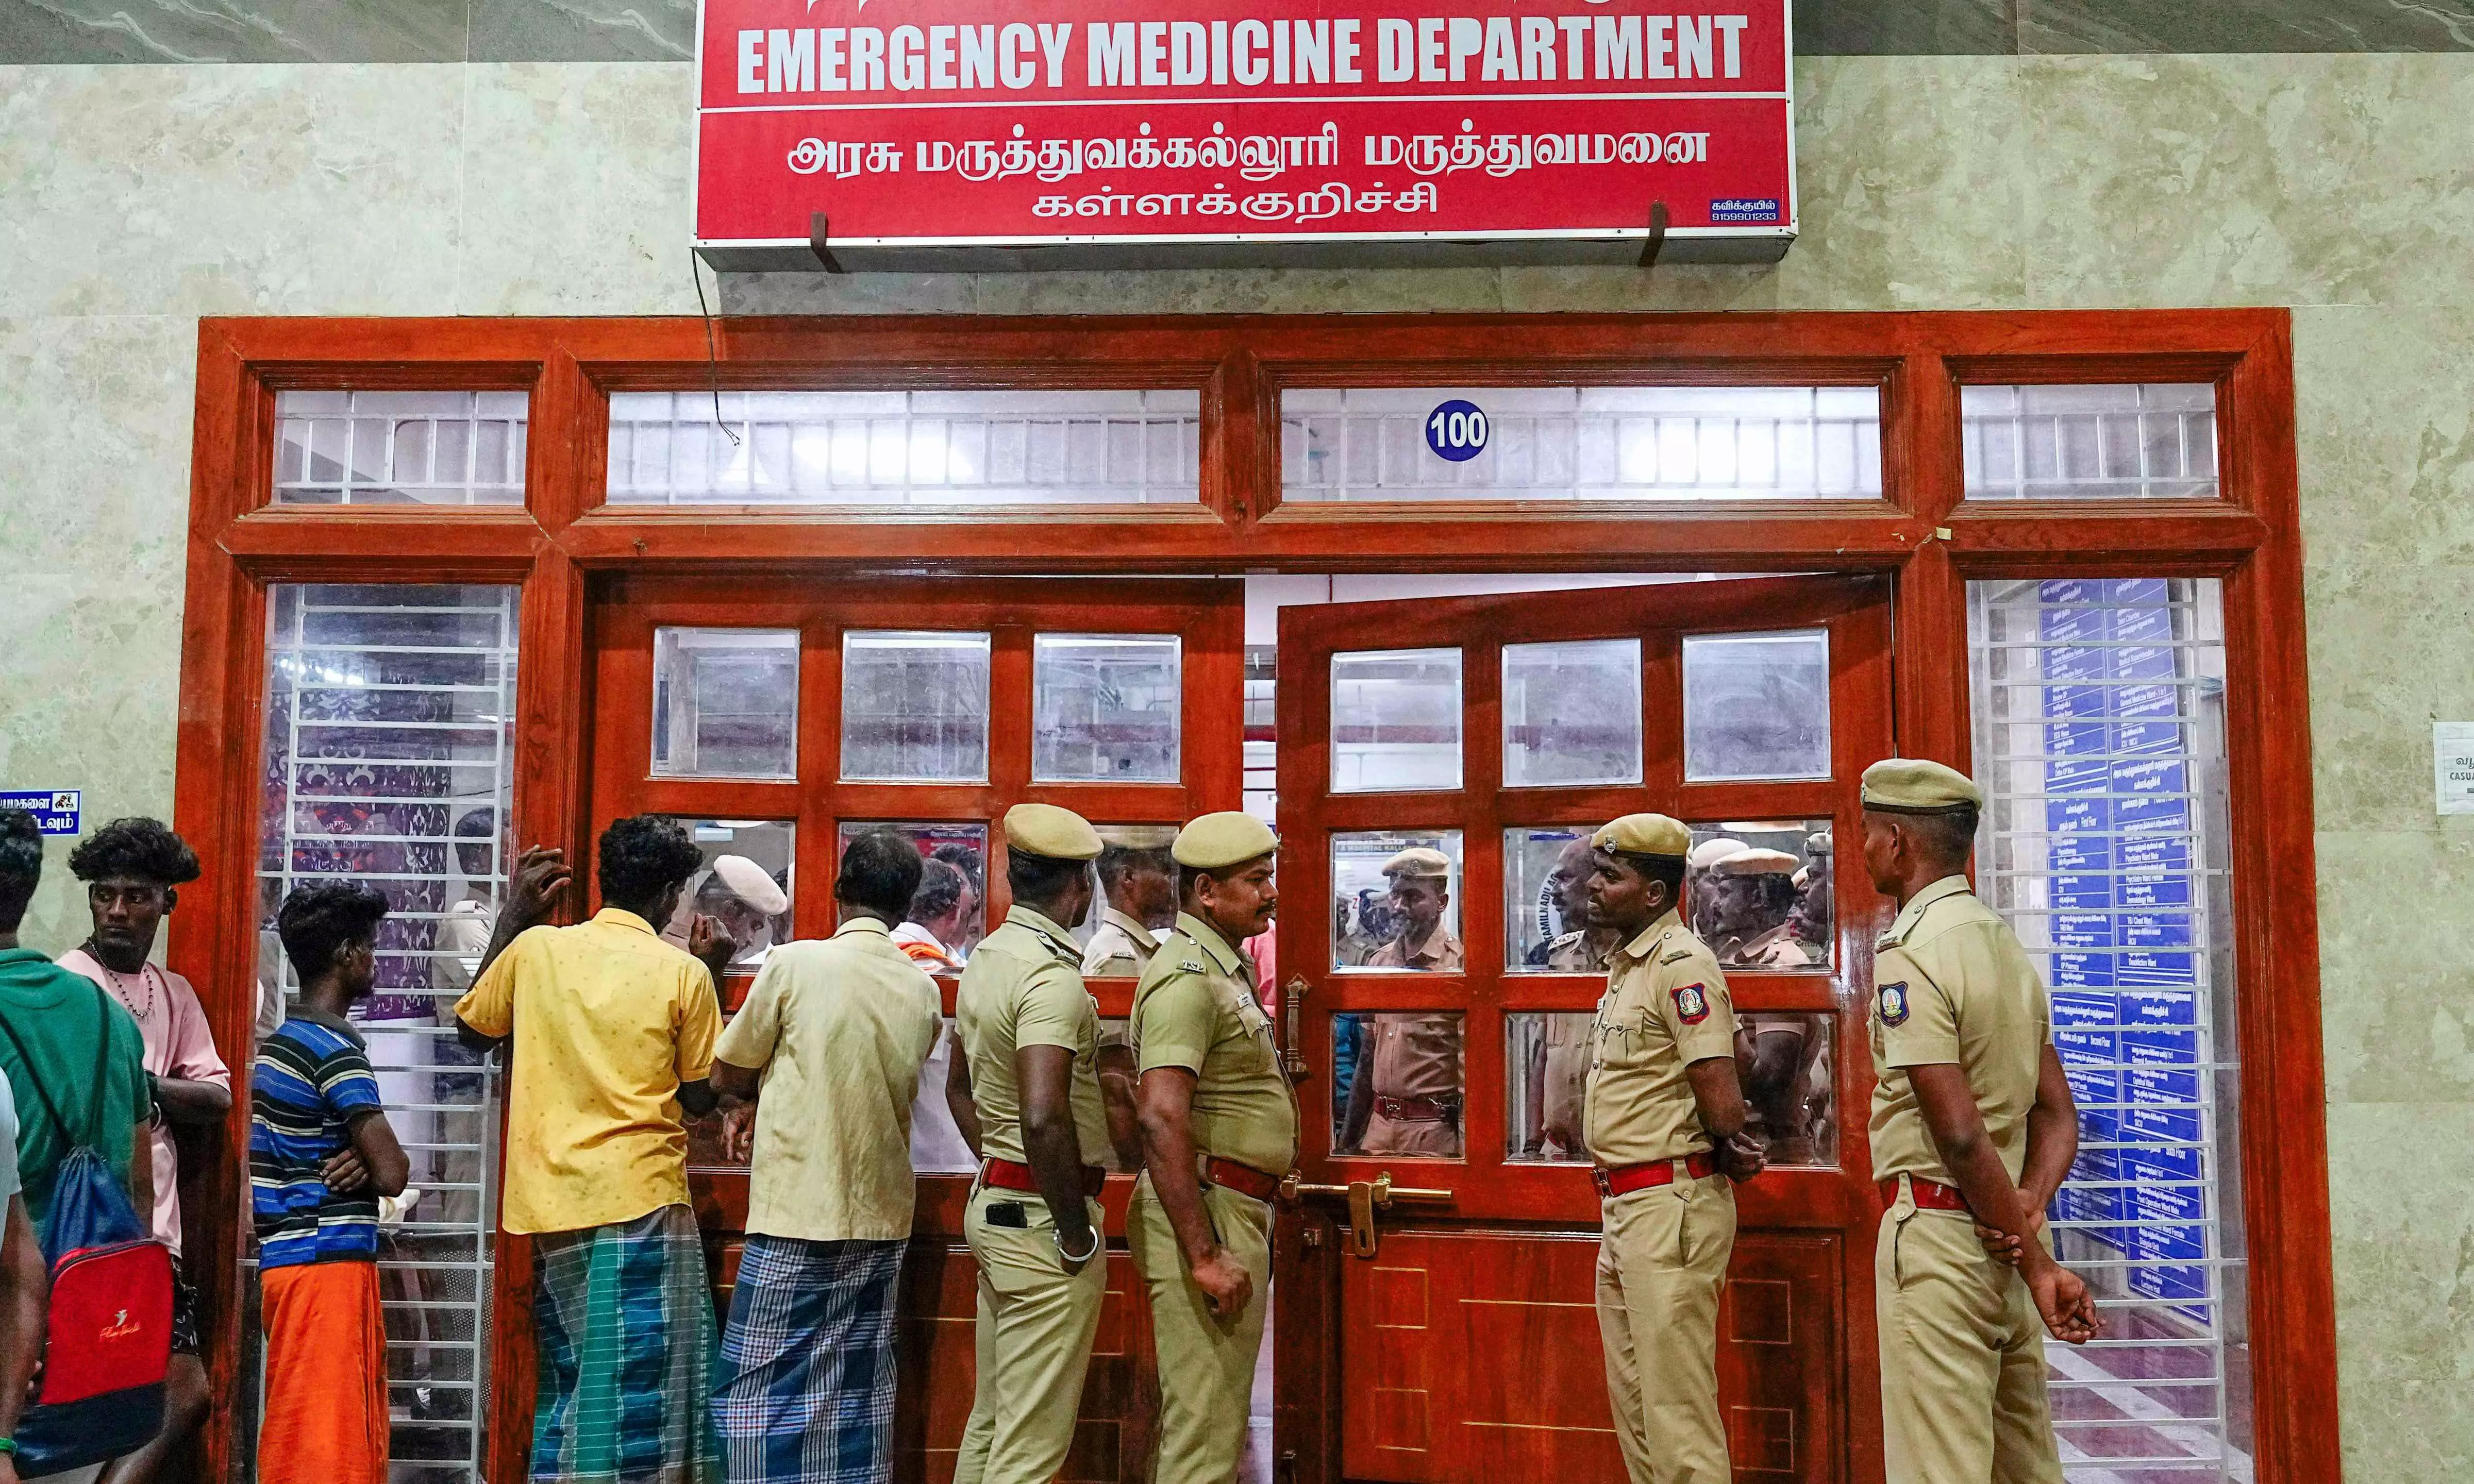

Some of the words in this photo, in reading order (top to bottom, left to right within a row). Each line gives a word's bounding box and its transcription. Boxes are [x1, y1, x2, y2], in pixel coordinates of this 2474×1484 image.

[737, 18, 1073, 94] EMERGENCY
[1087, 17, 1362, 88] MEDICINE
[1377, 14, 1748, 83] DEPARTMENT
[787, 135, 904, 178] அரசு
[916, 121, 1338, 180] மருத்துவக்கல்லூரி
[1364, 119, 1710, 176] மருத்துவமனை
[1031, 179, 1437, 223] கள்ளக்குறிச்சி
[1712, 200, 1776, 212] கவிக்குயில்
[1712, 212, 1777, 221] 9159901233
[1431, 411, 1486, 448] 100
